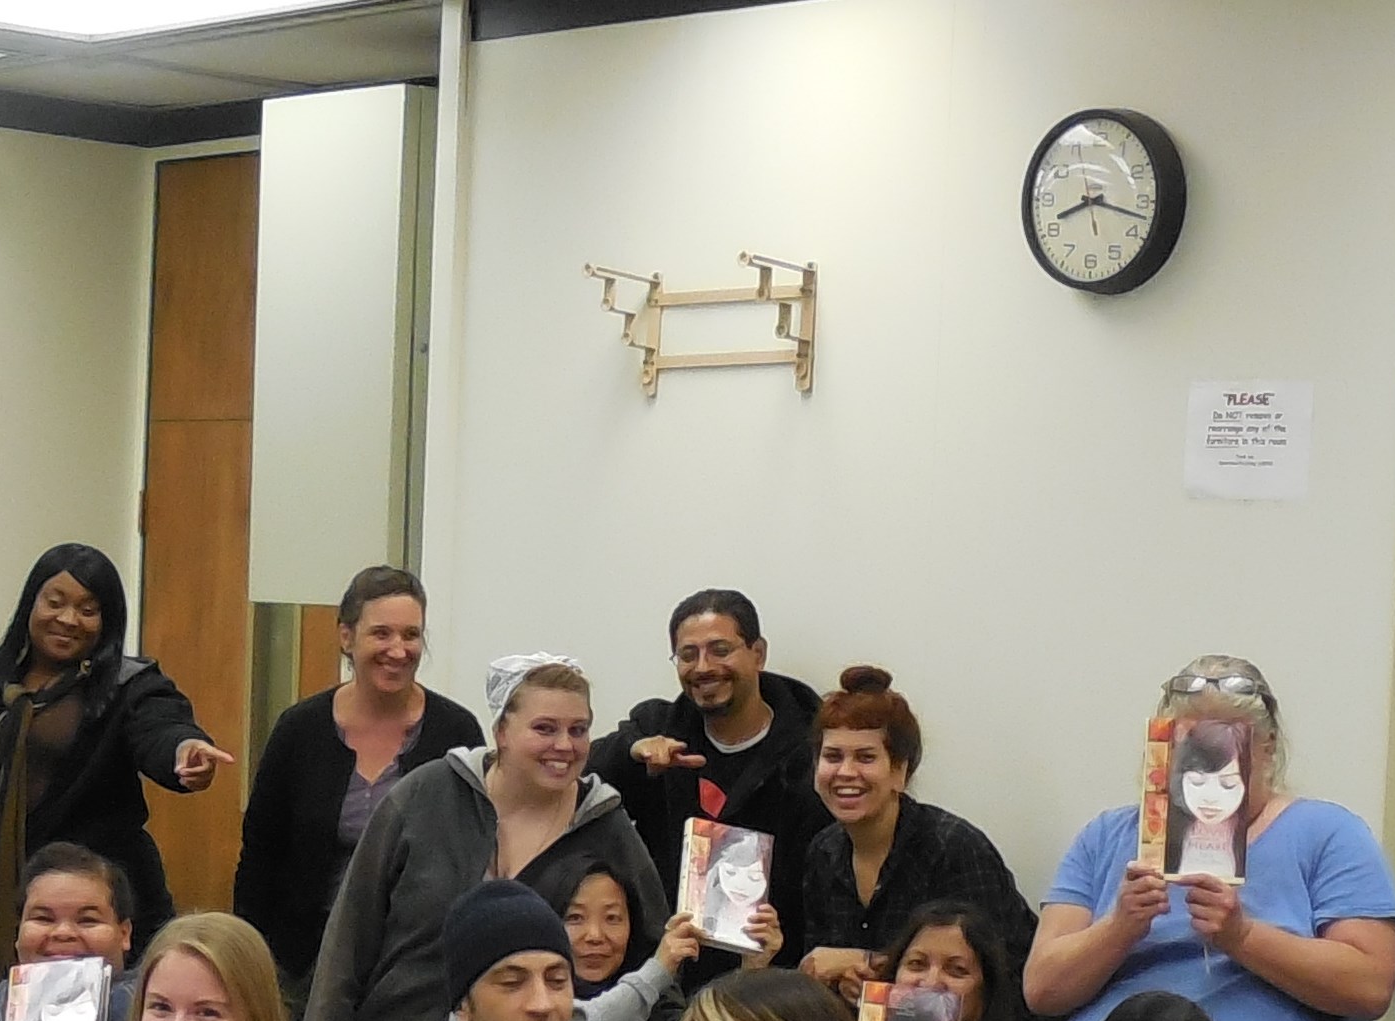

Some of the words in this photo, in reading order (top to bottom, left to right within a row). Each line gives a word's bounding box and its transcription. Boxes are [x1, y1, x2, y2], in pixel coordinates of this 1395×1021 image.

[1131, 164, 1144, 179] 2
[1042, 193, 1055, 207] 9
[1136, 194, 1150, 209] 3
[1047, 223, 1060, 237] 8
[1125, 225, 1139, 238] 4
[1063, 244, 1076, 257] 7
[1108, 245, 1122, 260] 5
[1084, 254, 1097, 269] 6
[1226, 411, 1242, 419] NOT
